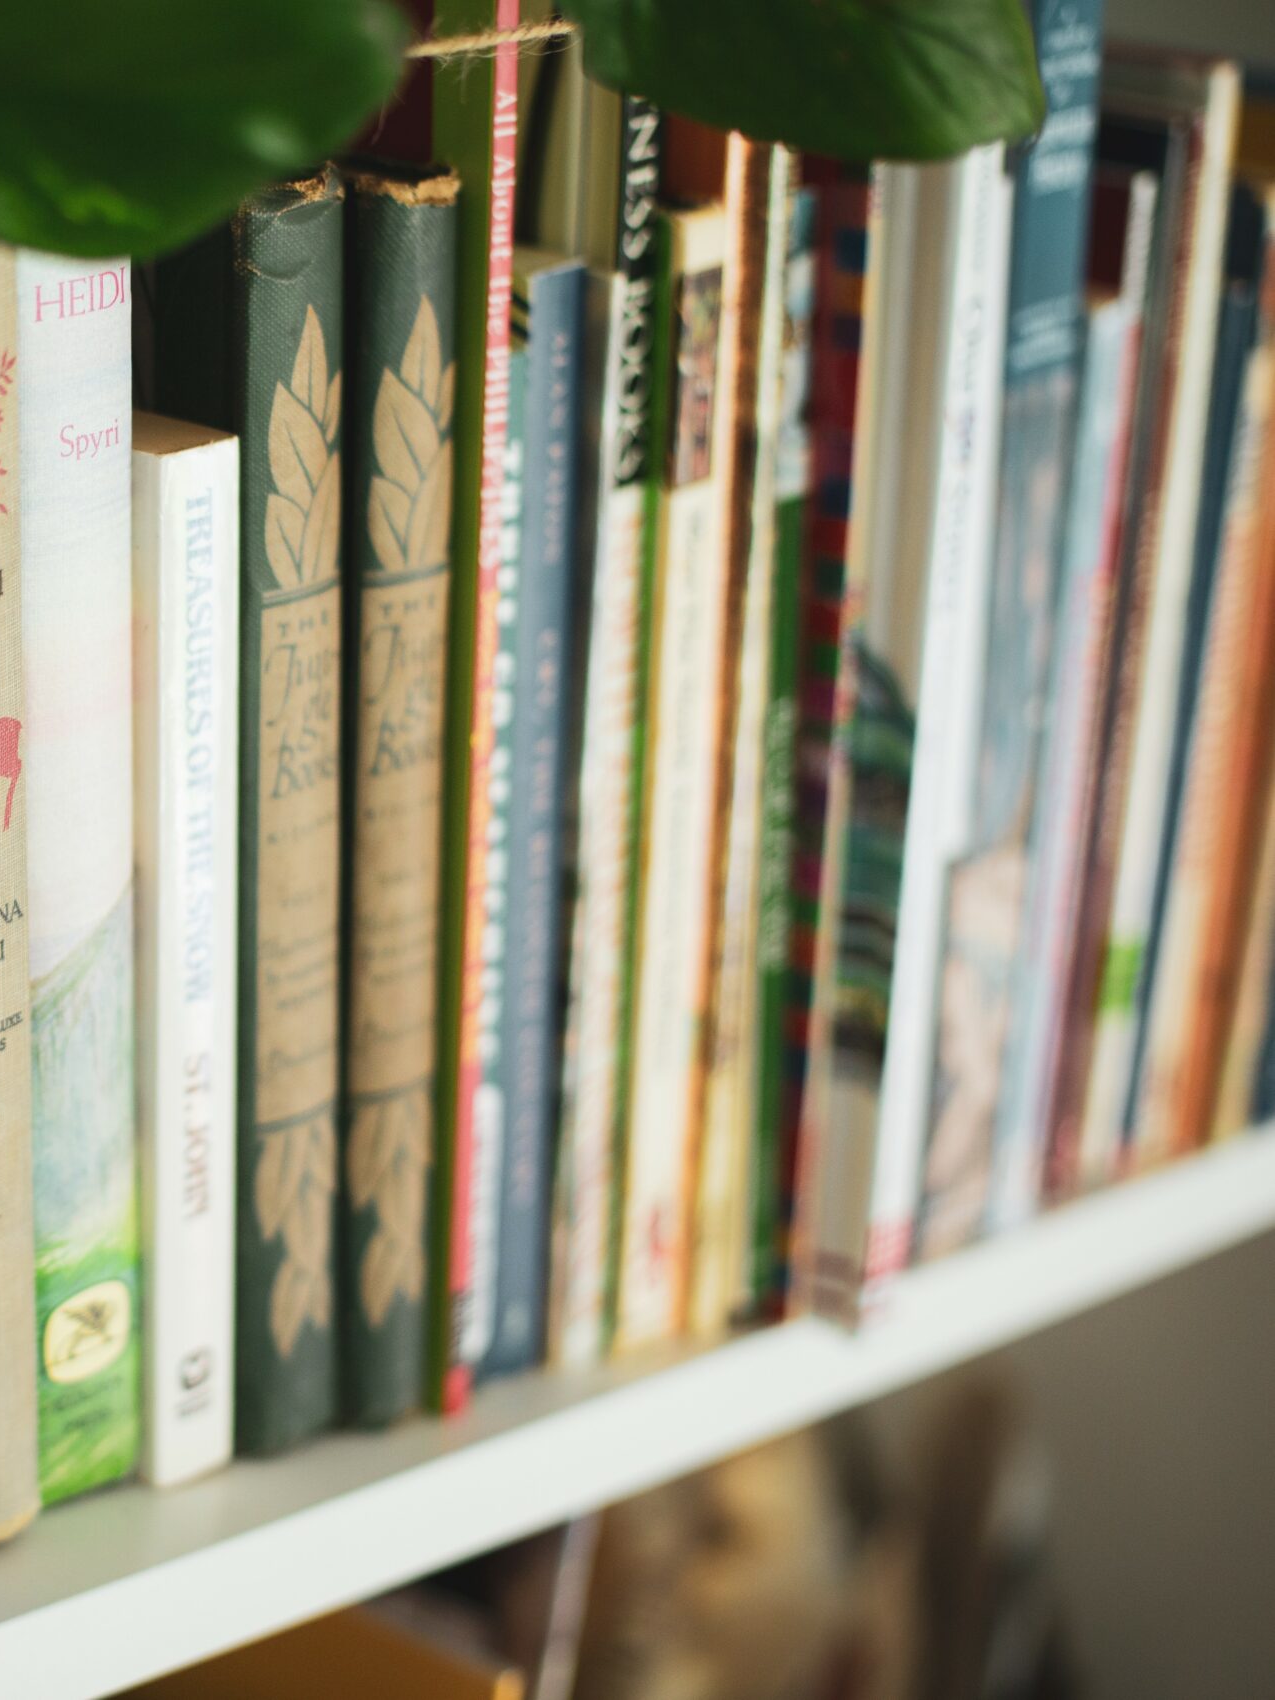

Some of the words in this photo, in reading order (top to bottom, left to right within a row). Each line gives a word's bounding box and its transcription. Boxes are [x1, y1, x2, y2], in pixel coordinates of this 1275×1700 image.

[495, 89, 517, 137] All
[490, 154, 516, 264] About
[622, 96, 659, 260] NESS
[35, 266, 126, 322] HEIDI
[60, 418, 120, 460] Spyri
[182, 488, 214, 736] TREASURES
